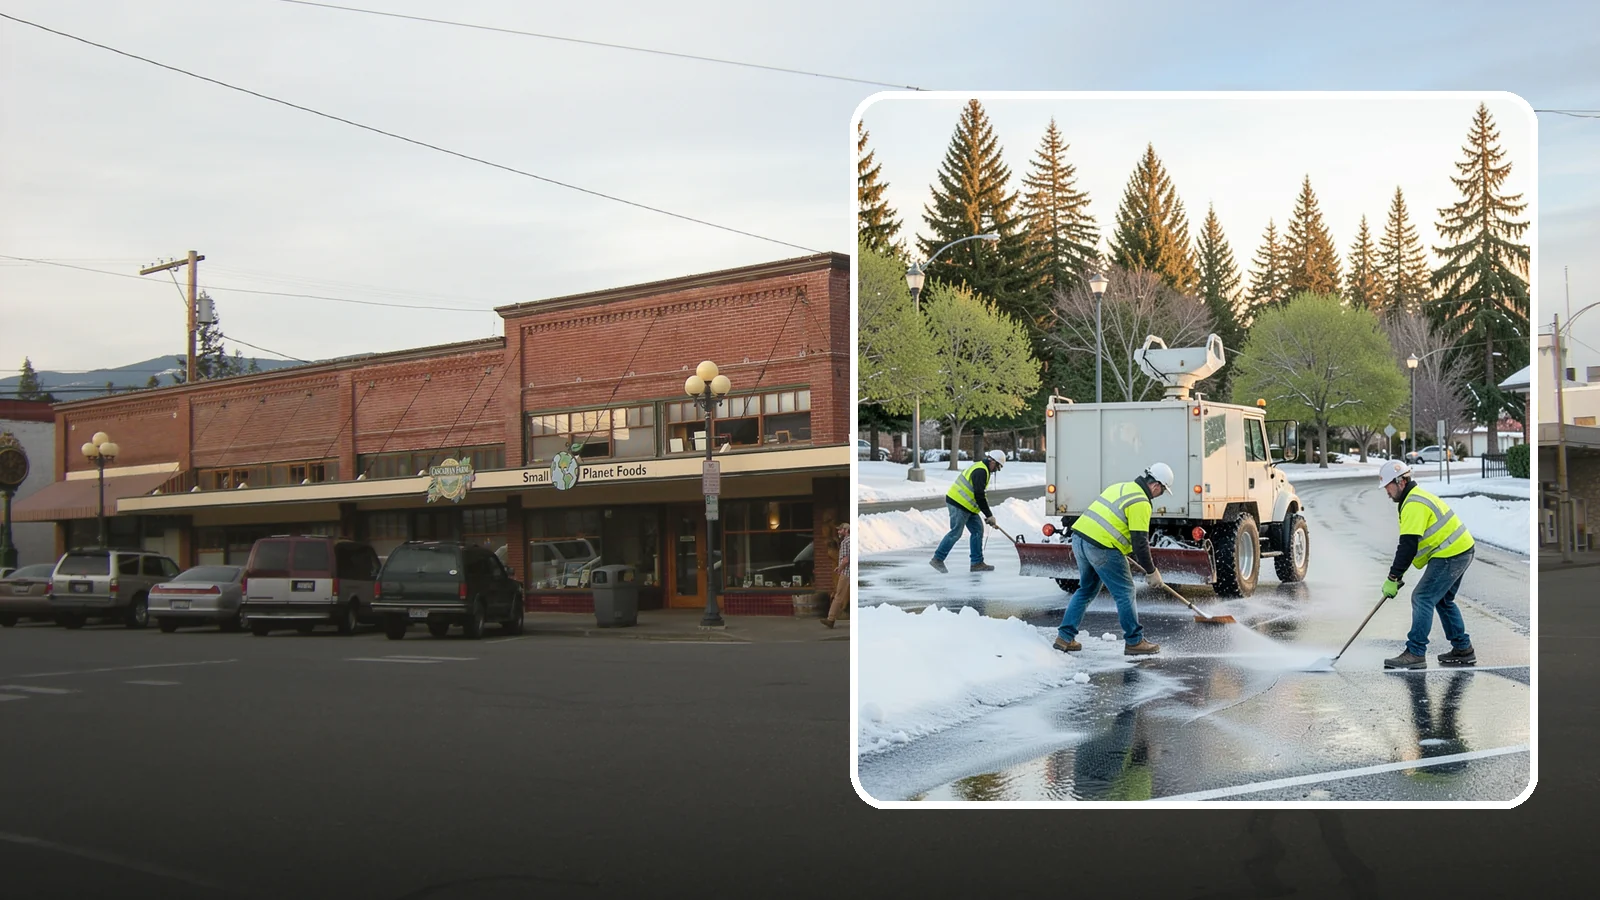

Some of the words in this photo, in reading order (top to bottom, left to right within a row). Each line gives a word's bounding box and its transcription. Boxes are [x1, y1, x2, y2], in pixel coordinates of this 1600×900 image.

[523, 471, 549, 483] Small
[583, 468, 614, 479] Planet
[617, 464, 647, 477] Foods
